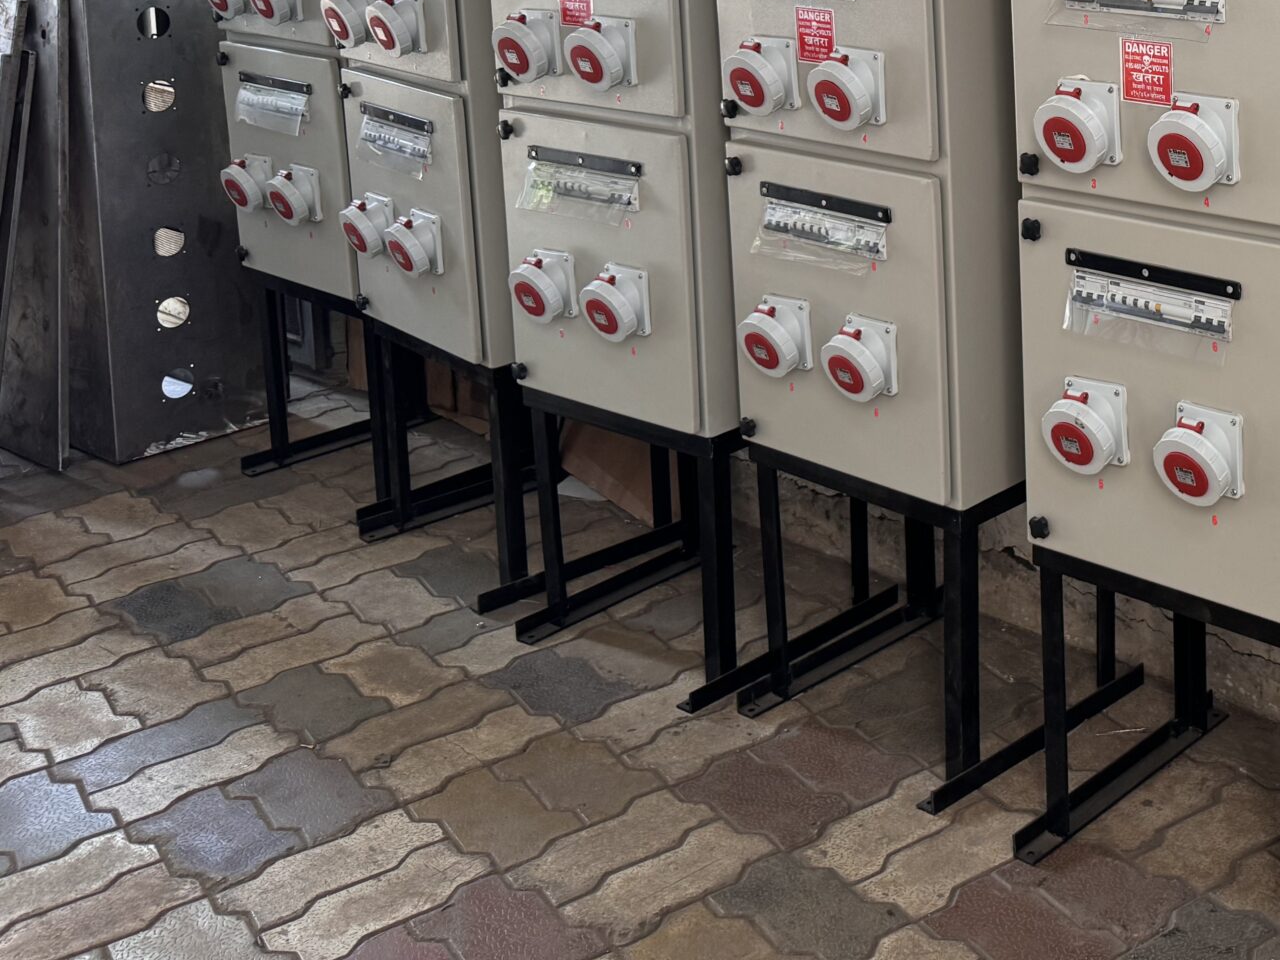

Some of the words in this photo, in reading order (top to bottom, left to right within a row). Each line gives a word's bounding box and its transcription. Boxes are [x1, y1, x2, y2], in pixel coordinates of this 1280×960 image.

[799, 10, 830, 22] DANGER
[1204, 25, 1211, 36] 4
[1126, 42, 1168, 56] DANGER
[1152, 65, 1168, 73] VOLTS
[1130, 72, 1164, 85] खतरा
[1204, 197, 1210, 208] 4
